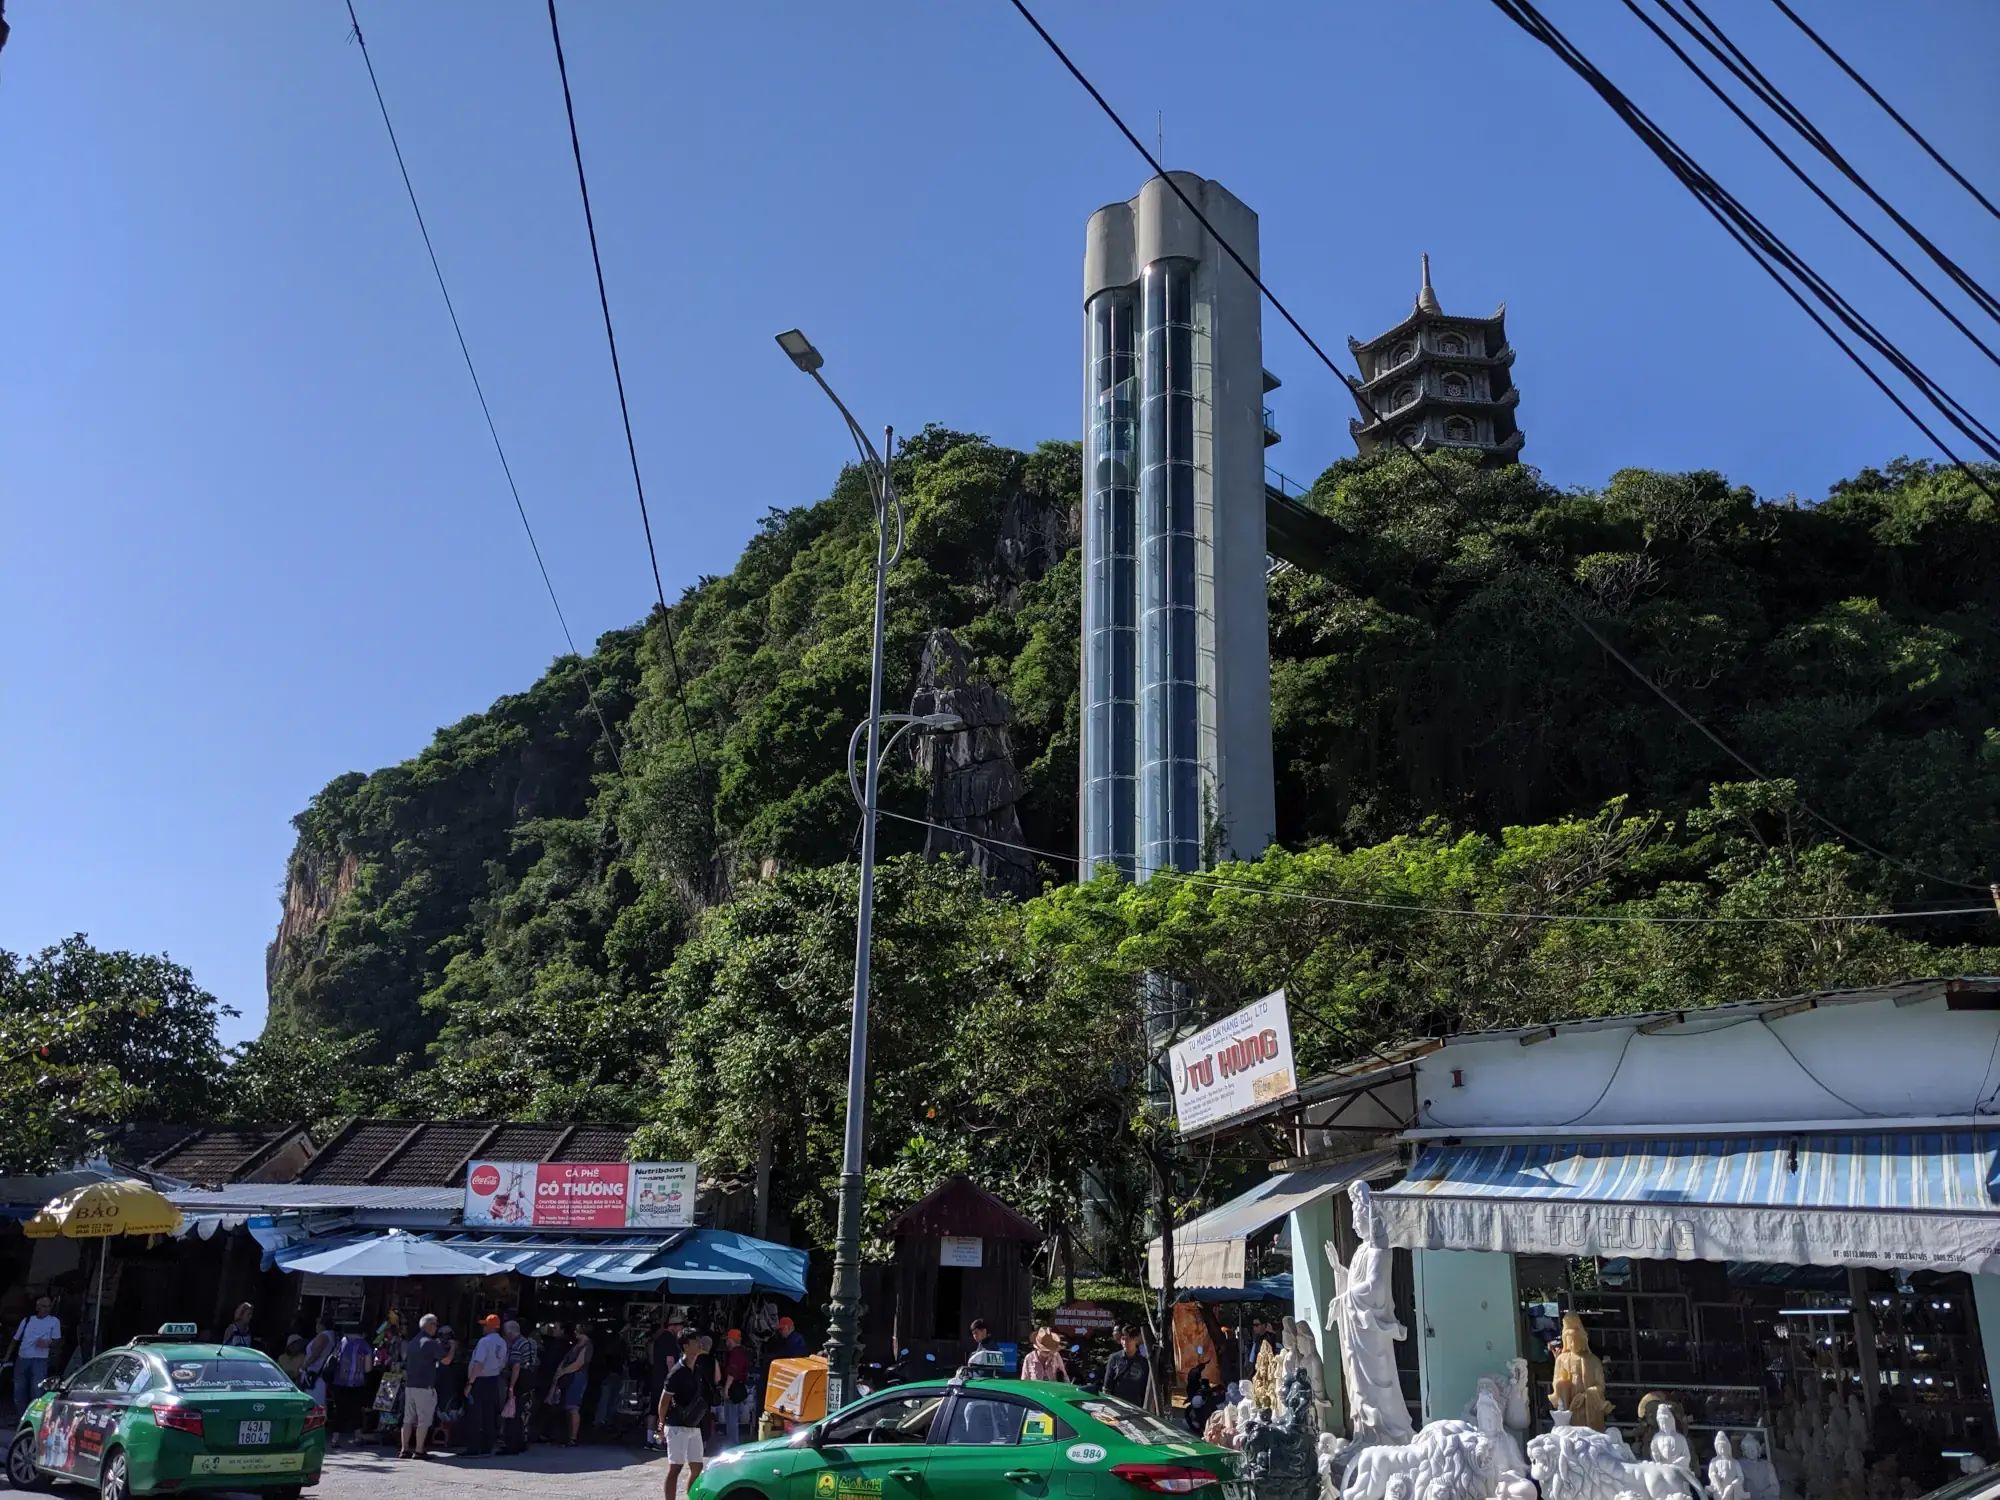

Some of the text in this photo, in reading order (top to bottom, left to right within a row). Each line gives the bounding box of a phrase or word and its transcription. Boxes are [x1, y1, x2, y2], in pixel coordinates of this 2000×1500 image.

[581, 1168, 600, 1177] PHÊ
[635, 1166, 684, 1176] Nutriboost
[538, 1181, 624, 1196] CÔ THƯƠNG
[247, 1421, 263, 1432] 43A
